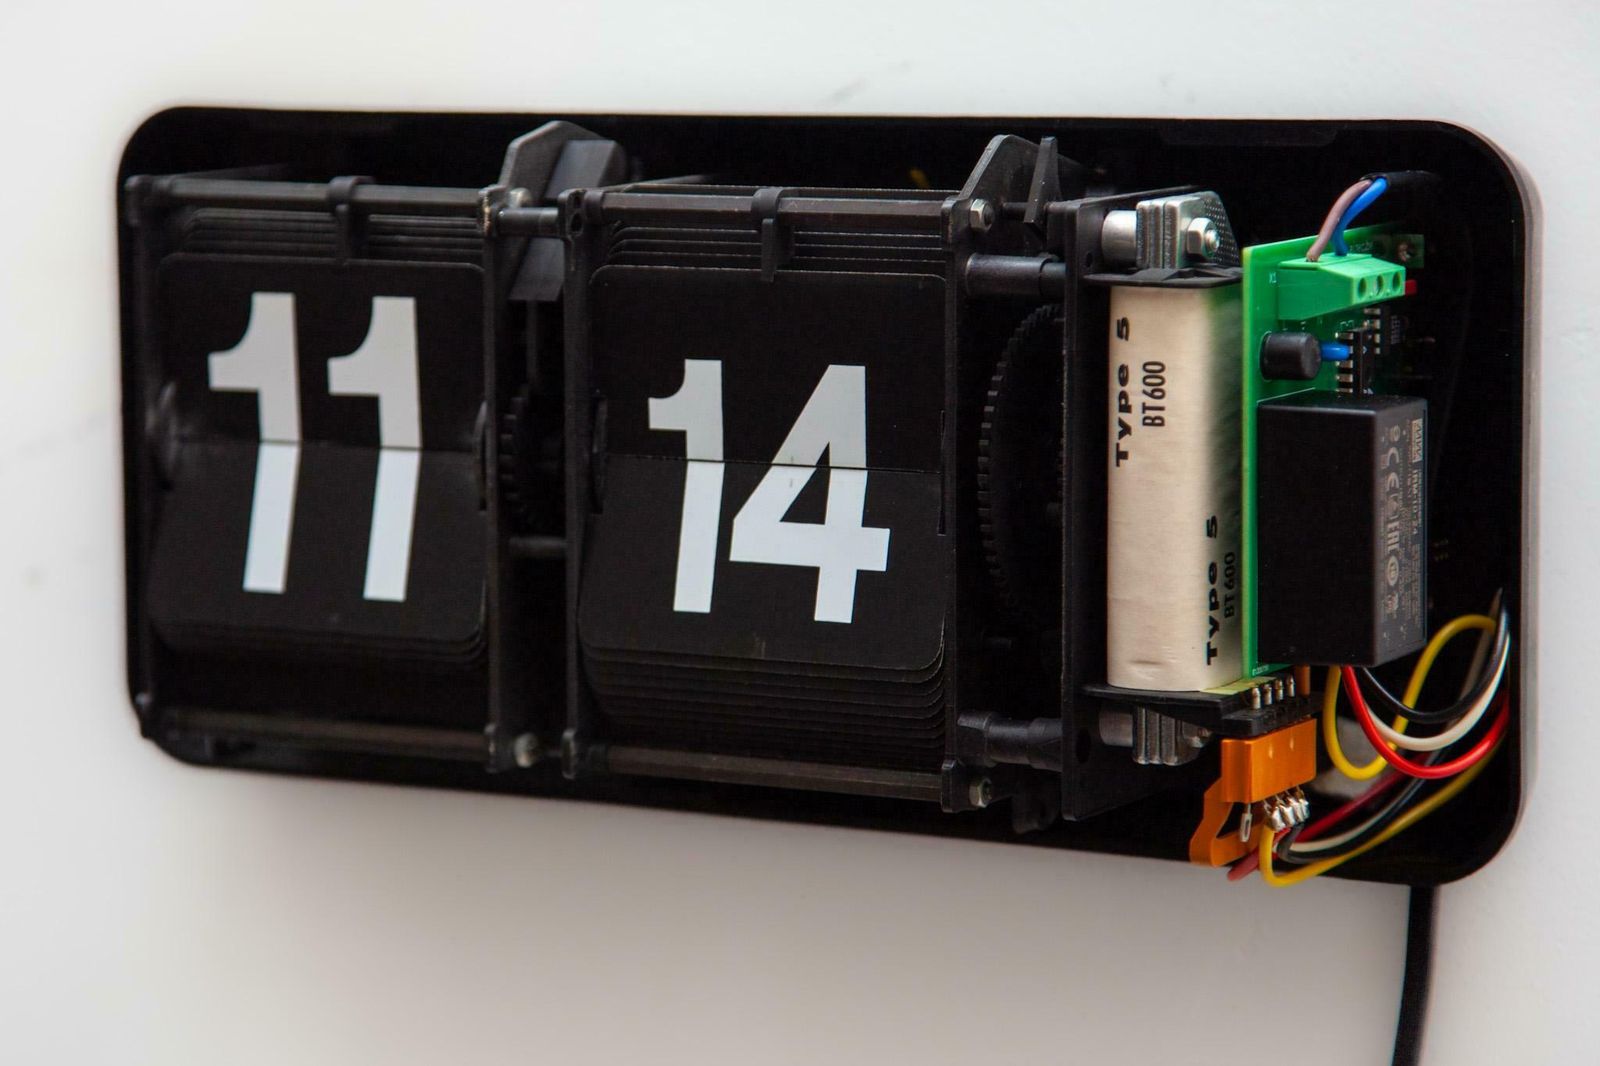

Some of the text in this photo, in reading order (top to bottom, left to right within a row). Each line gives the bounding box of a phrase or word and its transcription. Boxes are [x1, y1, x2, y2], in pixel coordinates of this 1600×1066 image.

[209, 293, 890, 624] 11 14
[1116, 317, 1132, 467] Type 5
[1142, 360, 1166, 427] BT600
[1206, 515, 1220, 666] Type 5
[1224, 551, 1236, 618] BT600
